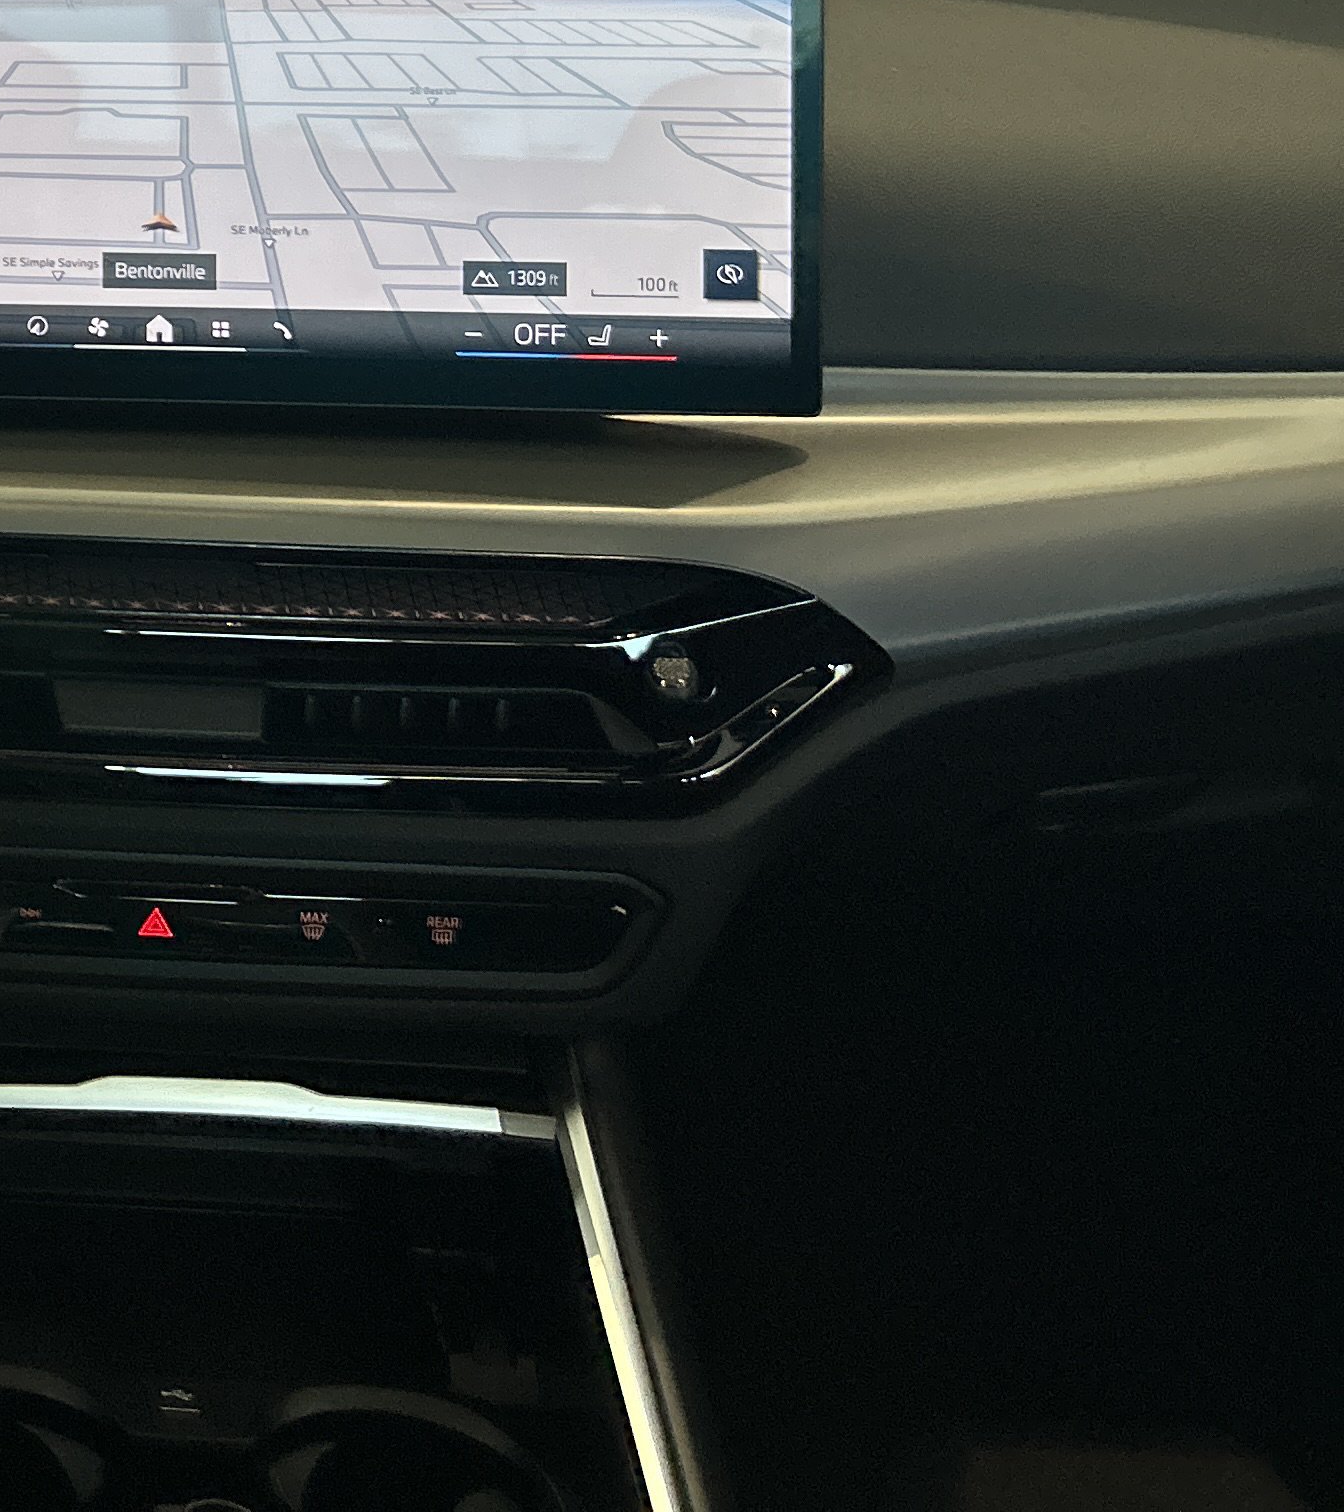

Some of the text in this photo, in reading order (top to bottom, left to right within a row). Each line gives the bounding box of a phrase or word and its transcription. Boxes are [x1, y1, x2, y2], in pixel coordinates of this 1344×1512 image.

[231, 225, 246, 237] SE
[294, 225, 309, 237] Ln
[2, 255, 100, 273] SE Simple Savings
[114, 260, 207, 281] Bentonville
[507, 269, 560, 287] 1309 ft
[637, 277, 679, 293] 100 ft
[513, 324, 567, 346] OFF
[299, 911, 329, 925] MAX
[426, 915, 460, 929] REAR
